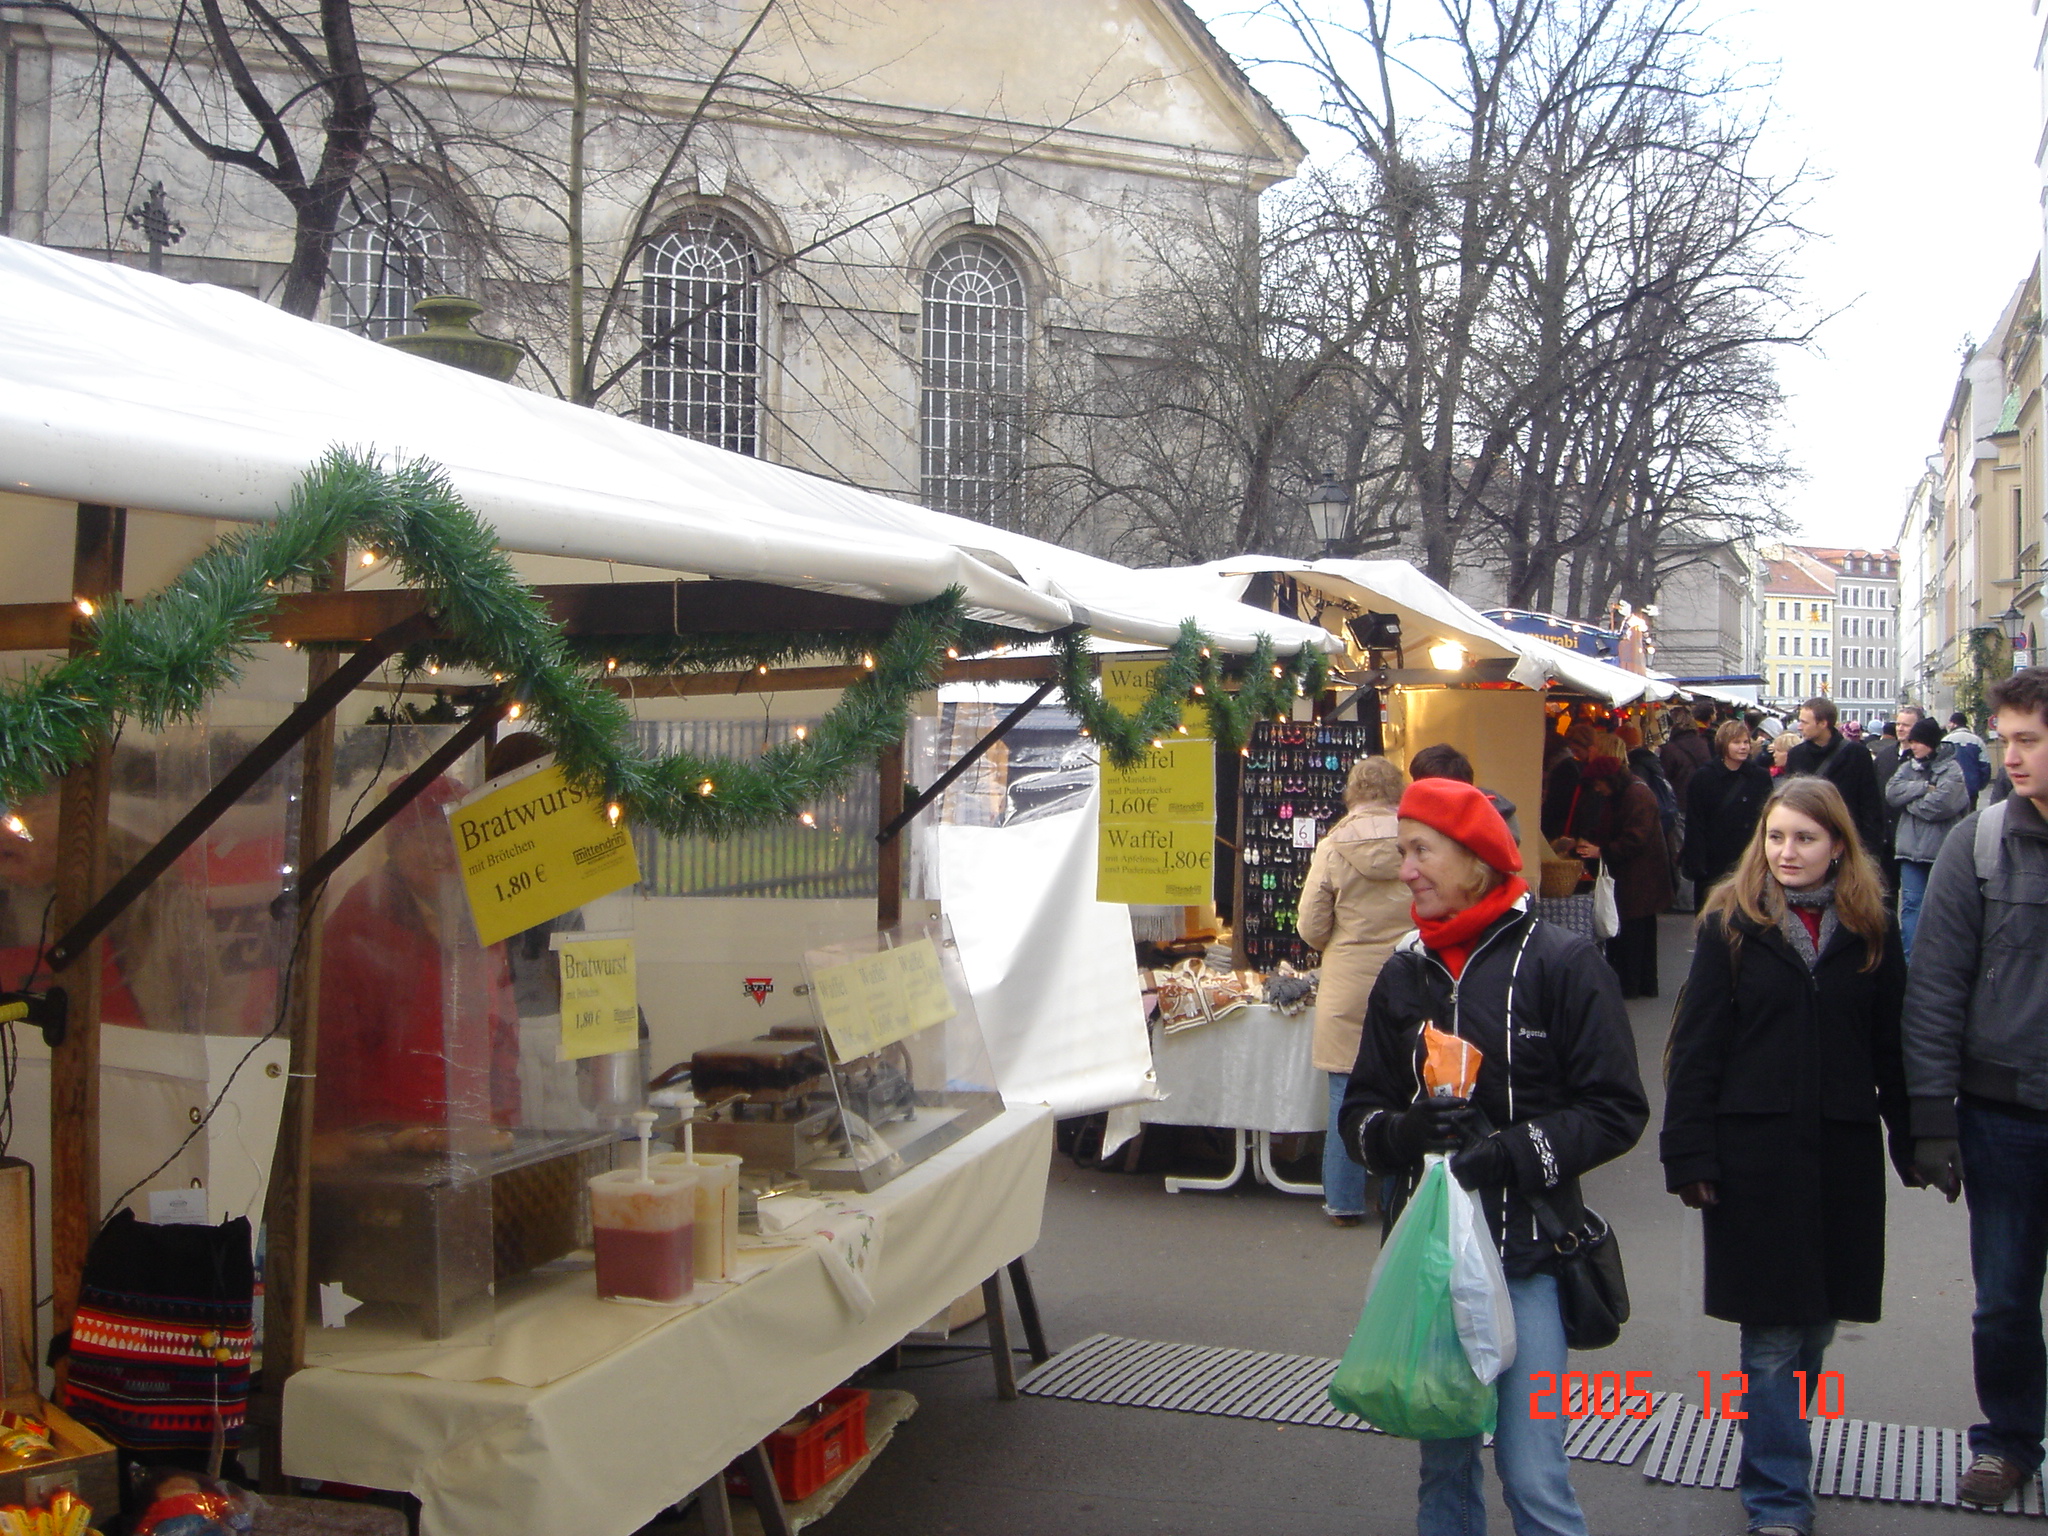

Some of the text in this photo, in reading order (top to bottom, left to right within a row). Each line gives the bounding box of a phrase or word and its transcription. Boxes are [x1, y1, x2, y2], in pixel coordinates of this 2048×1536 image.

[1110, 669, 1159, 688] Waff
[1112, 750, 1174, 770] affel
[1108, 829, 1174, 849] Waffel
[468, 839, 536, 876] mit Brötchen
[494, 863, 549, 902] 1,80 €
[565, 953, 628, 980] Bratwurst
